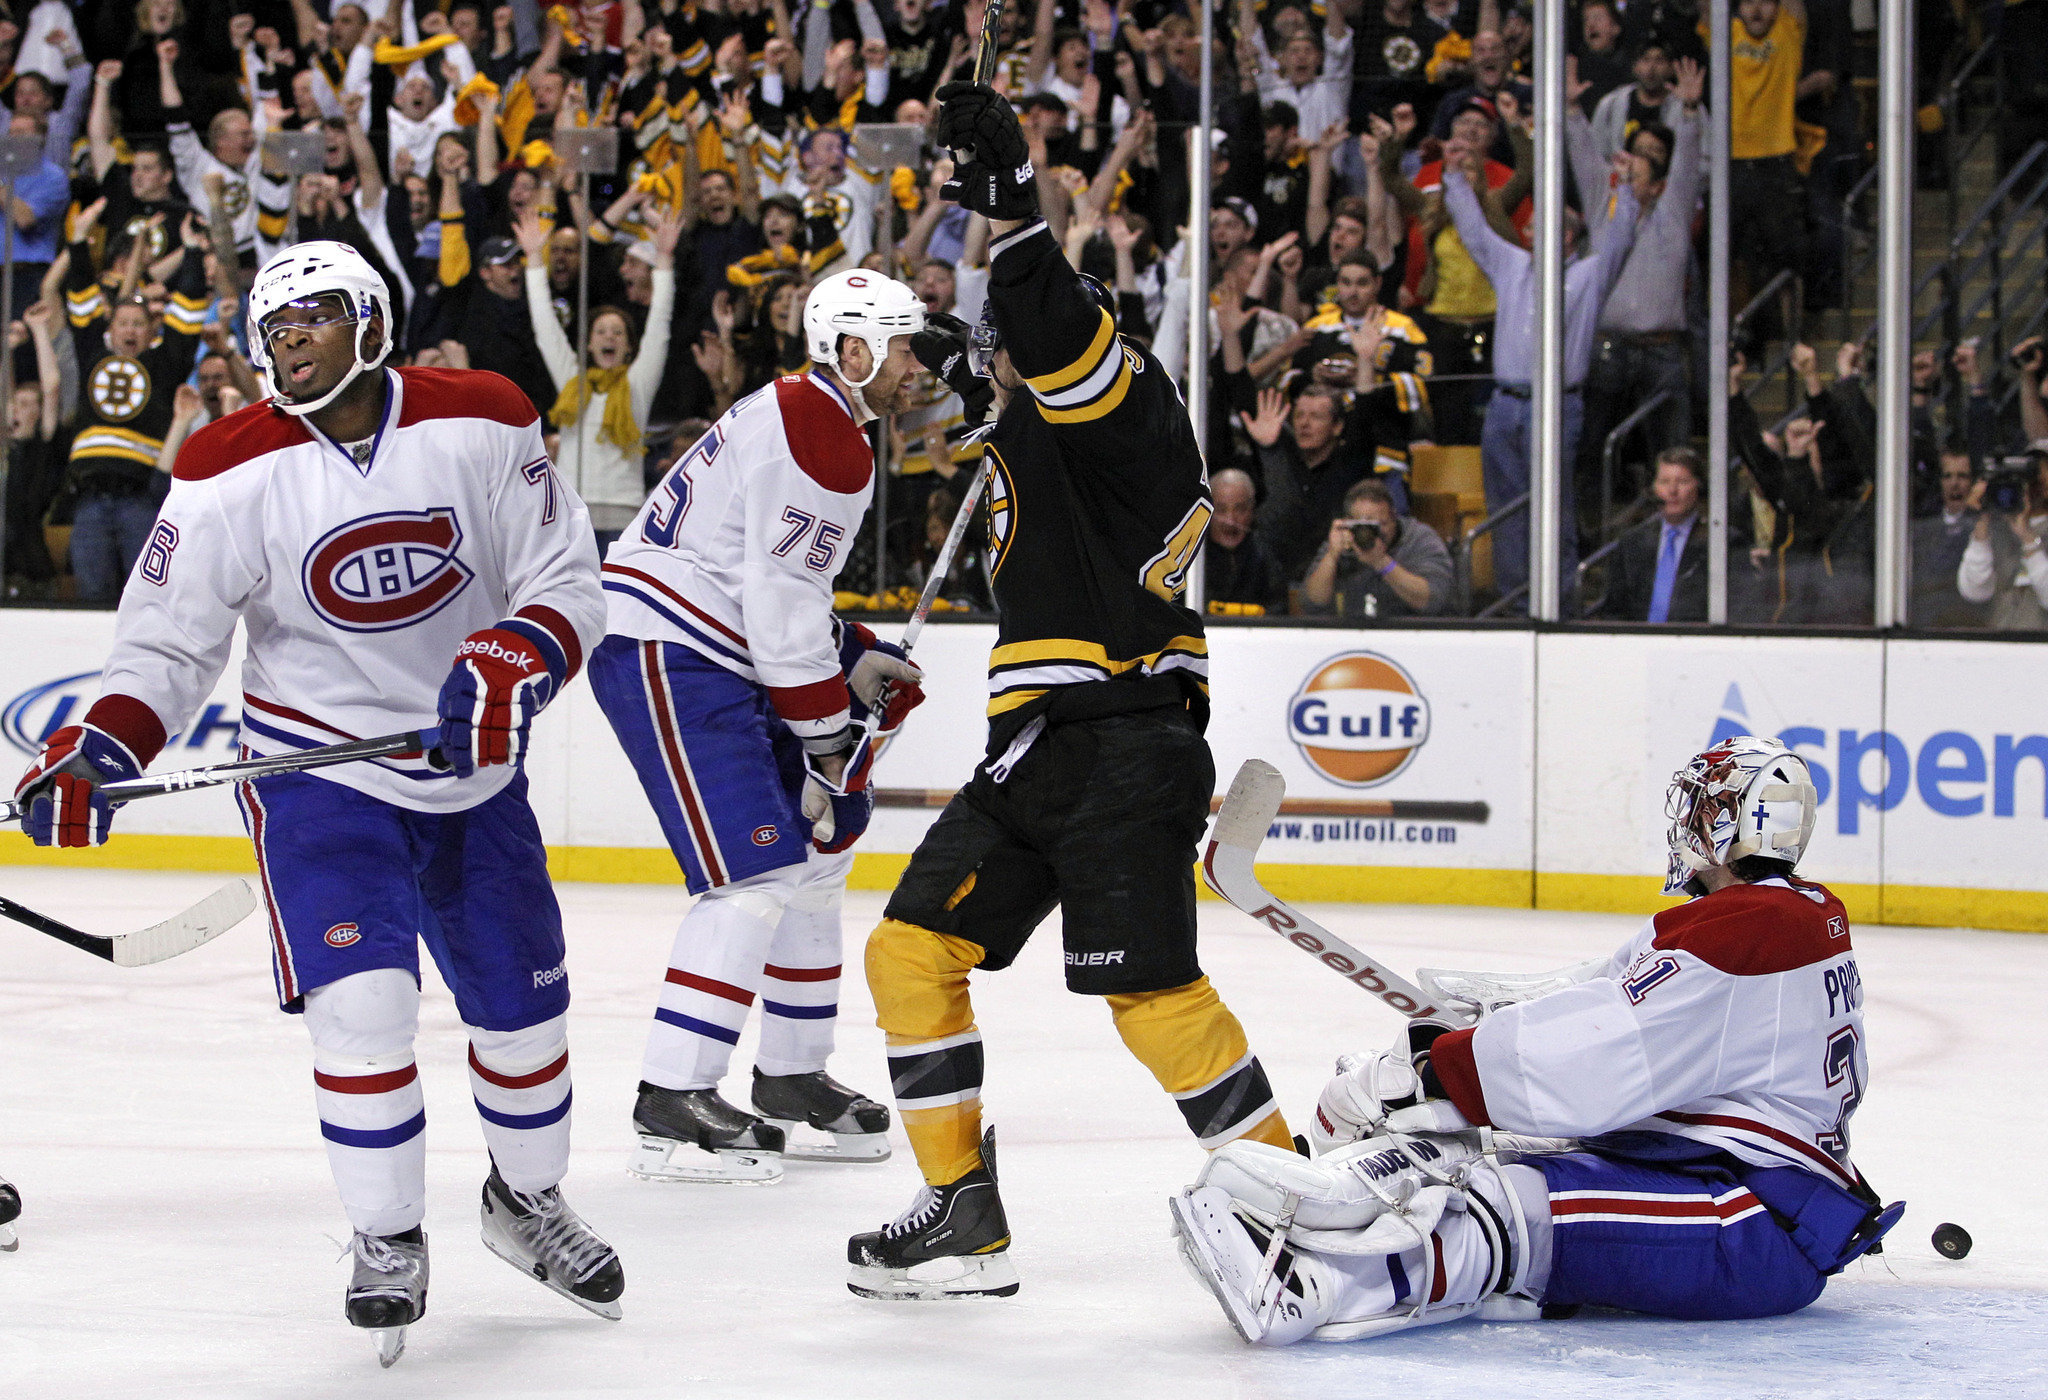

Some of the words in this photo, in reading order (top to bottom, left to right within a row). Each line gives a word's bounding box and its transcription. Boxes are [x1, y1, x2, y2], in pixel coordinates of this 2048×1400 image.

[772, 505, 846, 572] 75
[1292, 698, 1421, 738] Gulf
[1264, 818, 1458, 844] ww.gulfoil.com
[1249, 903, 1441, 1019] Reebo
